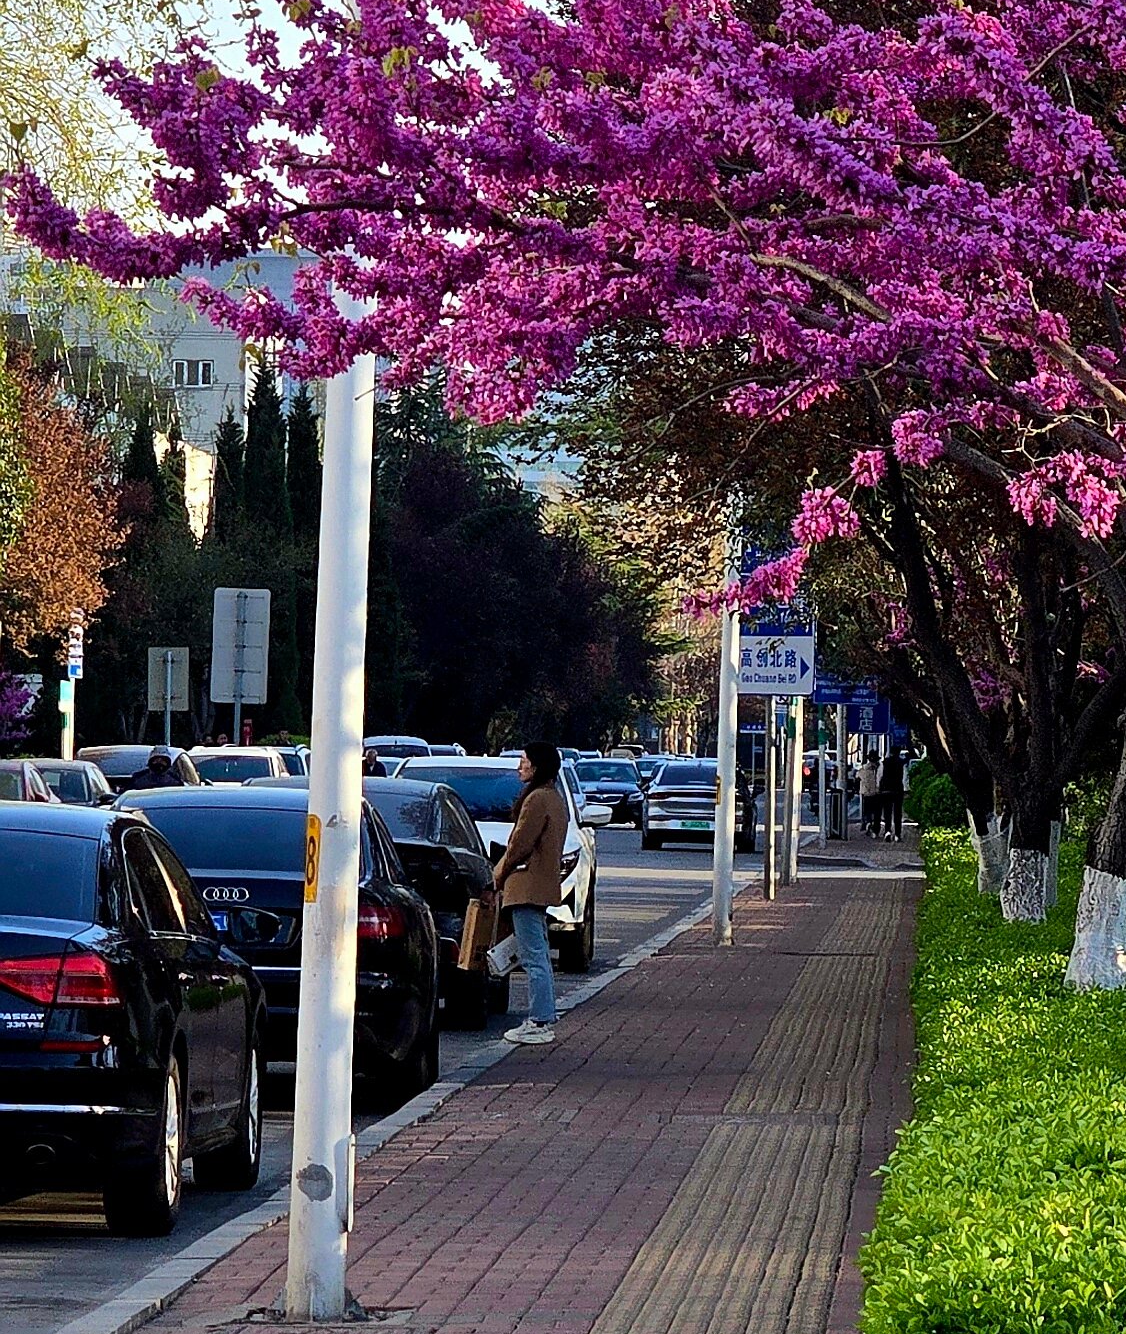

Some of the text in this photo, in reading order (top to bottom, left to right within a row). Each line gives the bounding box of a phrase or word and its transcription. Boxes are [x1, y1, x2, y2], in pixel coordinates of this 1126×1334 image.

[741, 648, 797, 668] 高创北路
[858, 706, 874, 731] 酒店
